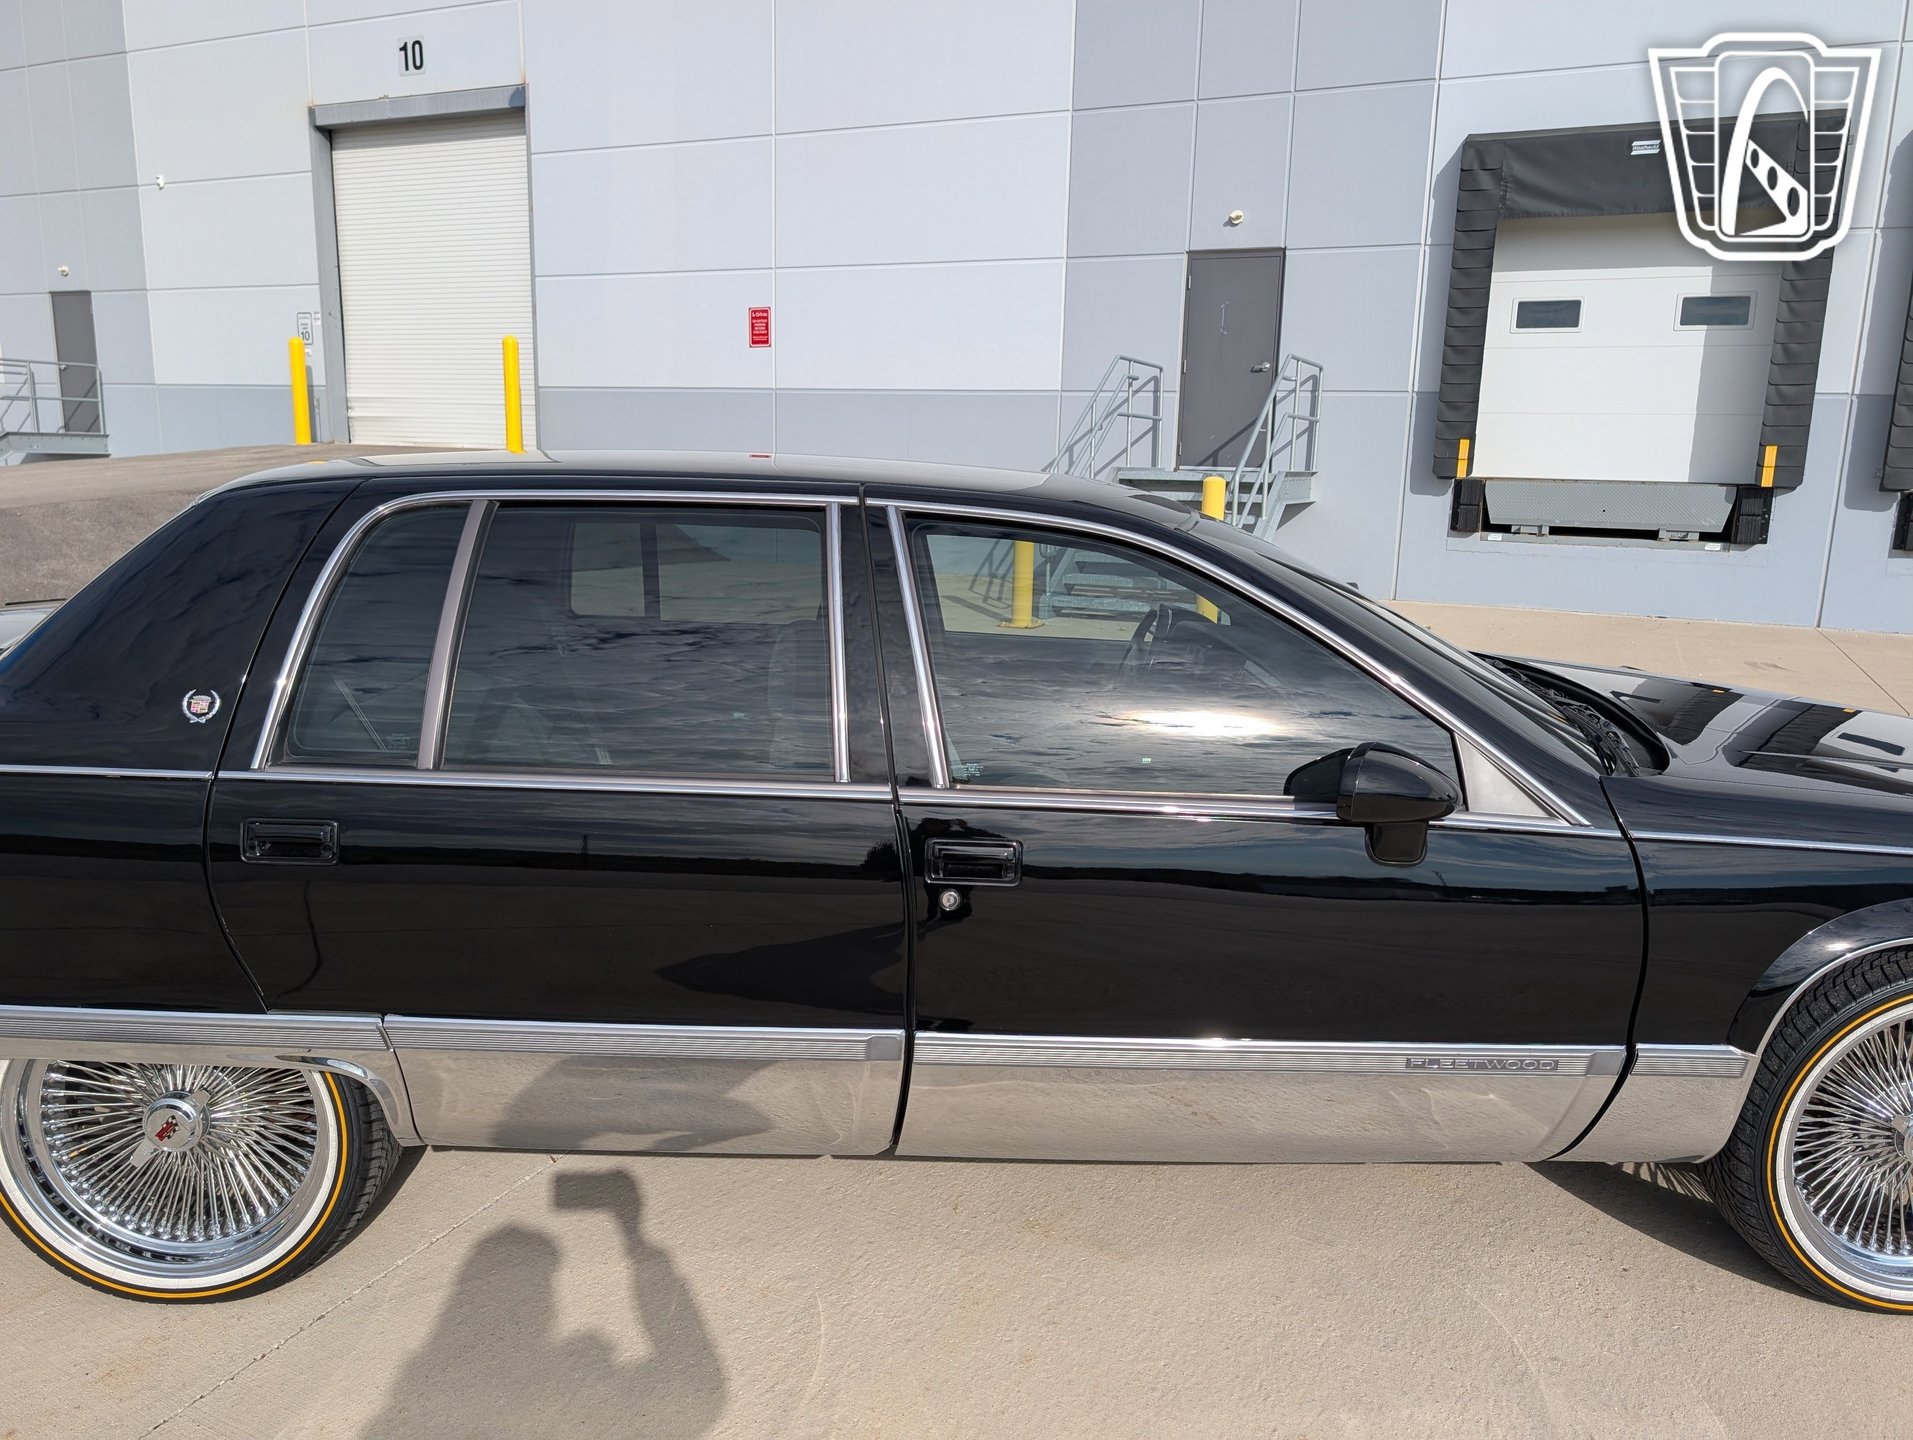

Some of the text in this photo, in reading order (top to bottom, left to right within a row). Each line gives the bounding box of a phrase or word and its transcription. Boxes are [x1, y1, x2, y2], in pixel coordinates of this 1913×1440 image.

[399, 40, 424, 71] 10
[300, 331, 311, 341] 10
[1410, 1058, 1555, 1070] FLEETWOOD
